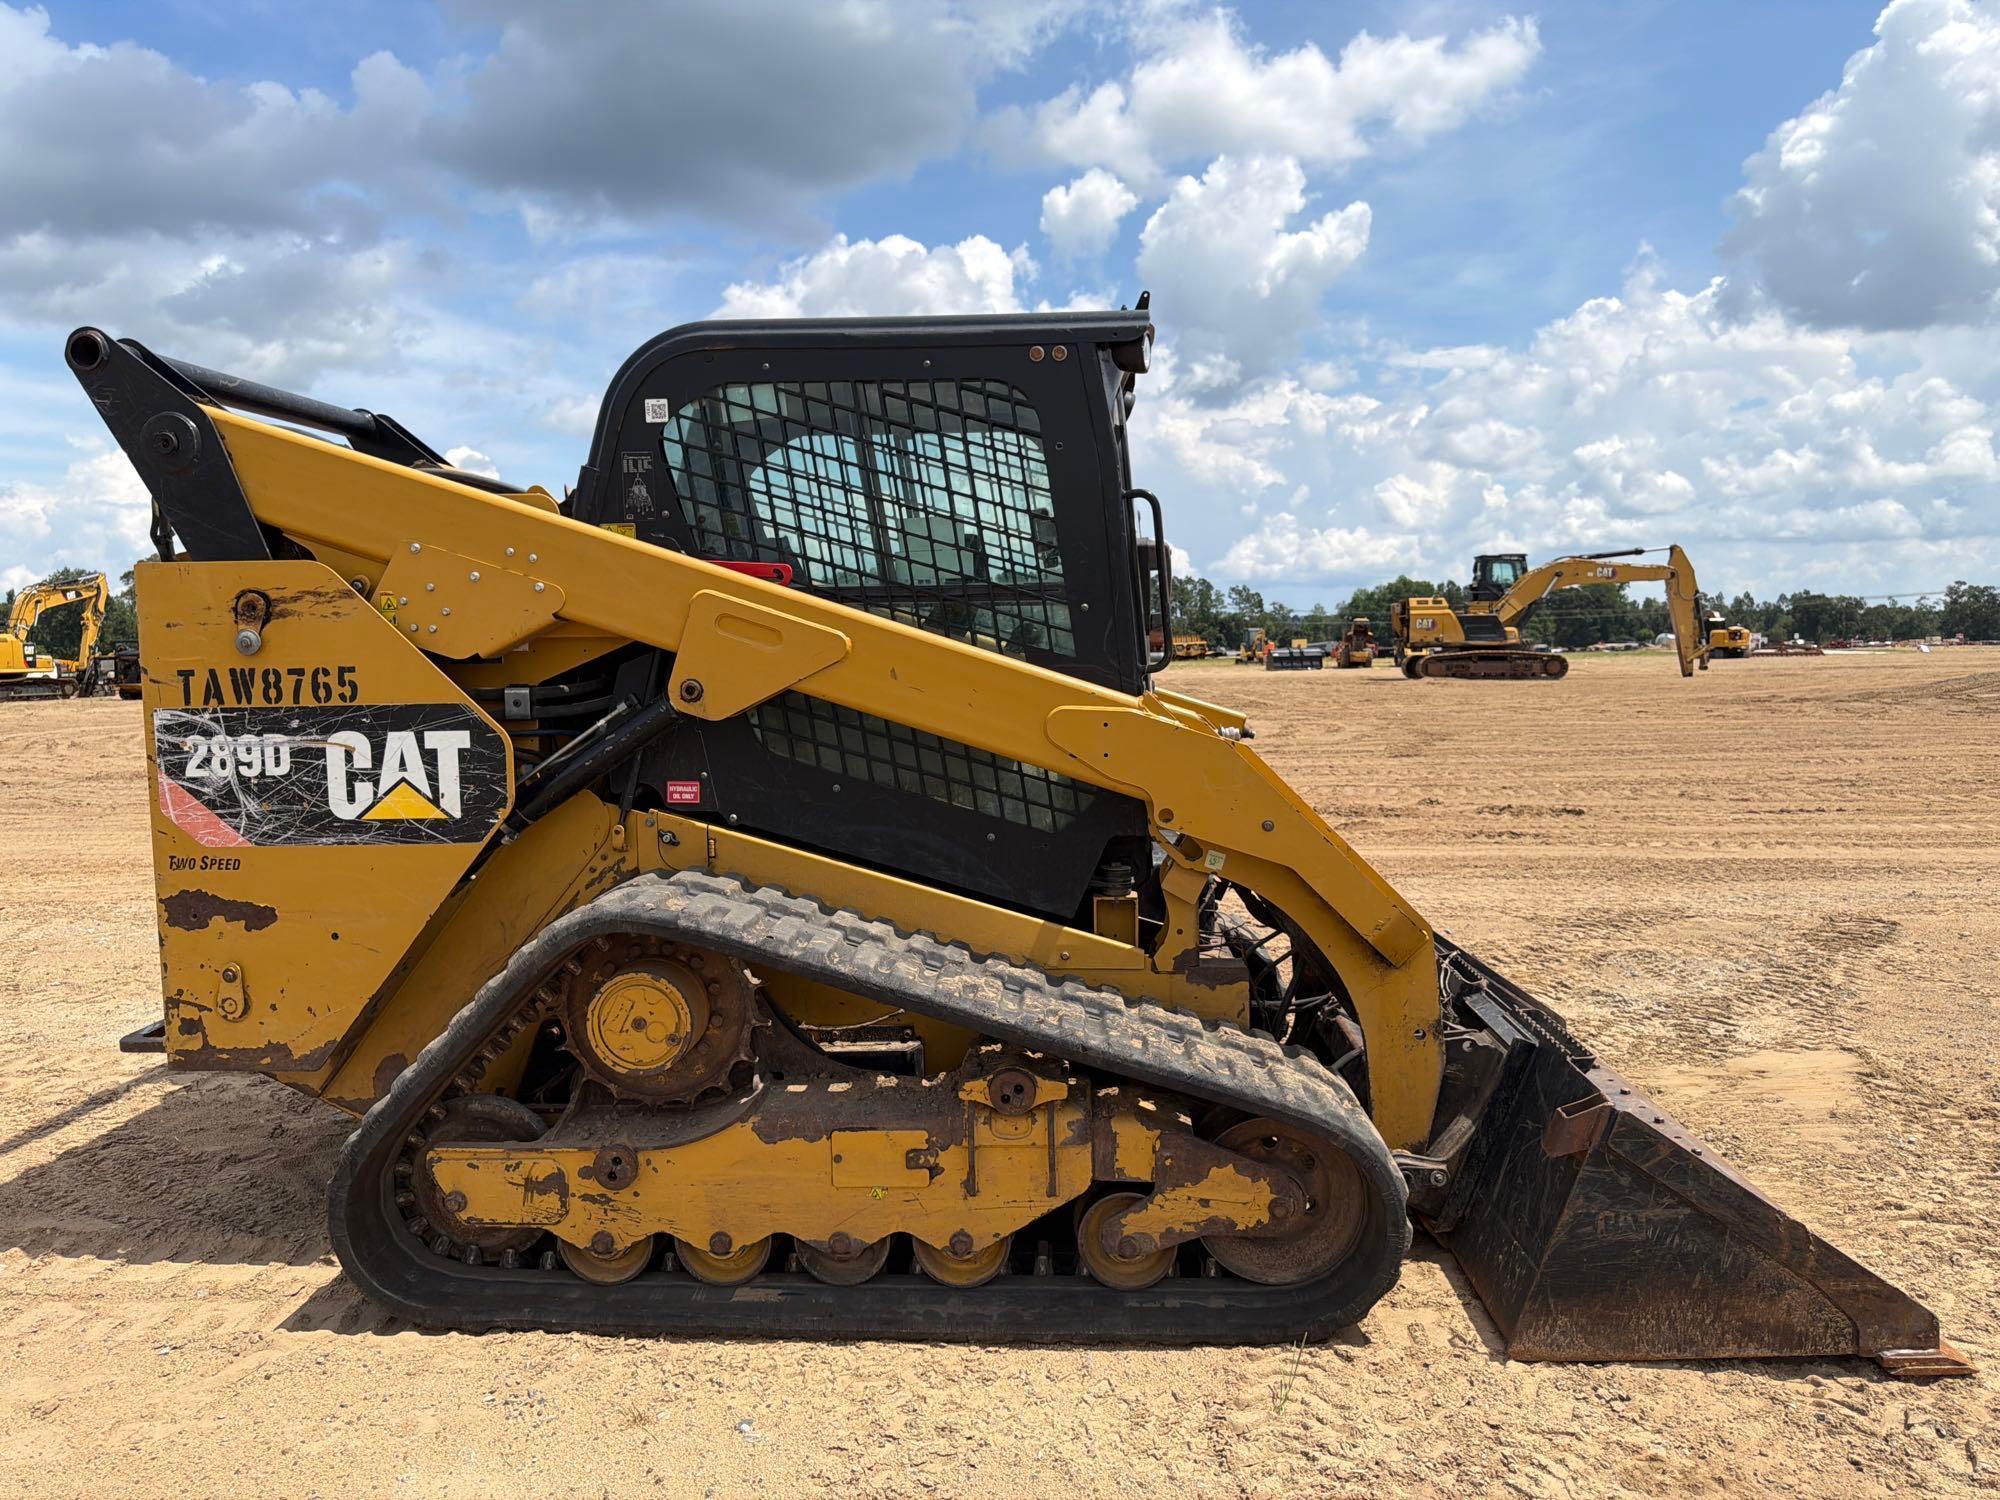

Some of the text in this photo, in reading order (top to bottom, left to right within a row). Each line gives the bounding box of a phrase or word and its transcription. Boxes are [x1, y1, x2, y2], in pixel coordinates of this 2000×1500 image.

[1597, 567, 1613, 577] CAT
[1416, 618, 1433, 629] CAT
[177, 666, 358, 705] TAW8765
[185, 730, 470, 820] 289D CAT
[200, 855, 241, 871] SPEED
